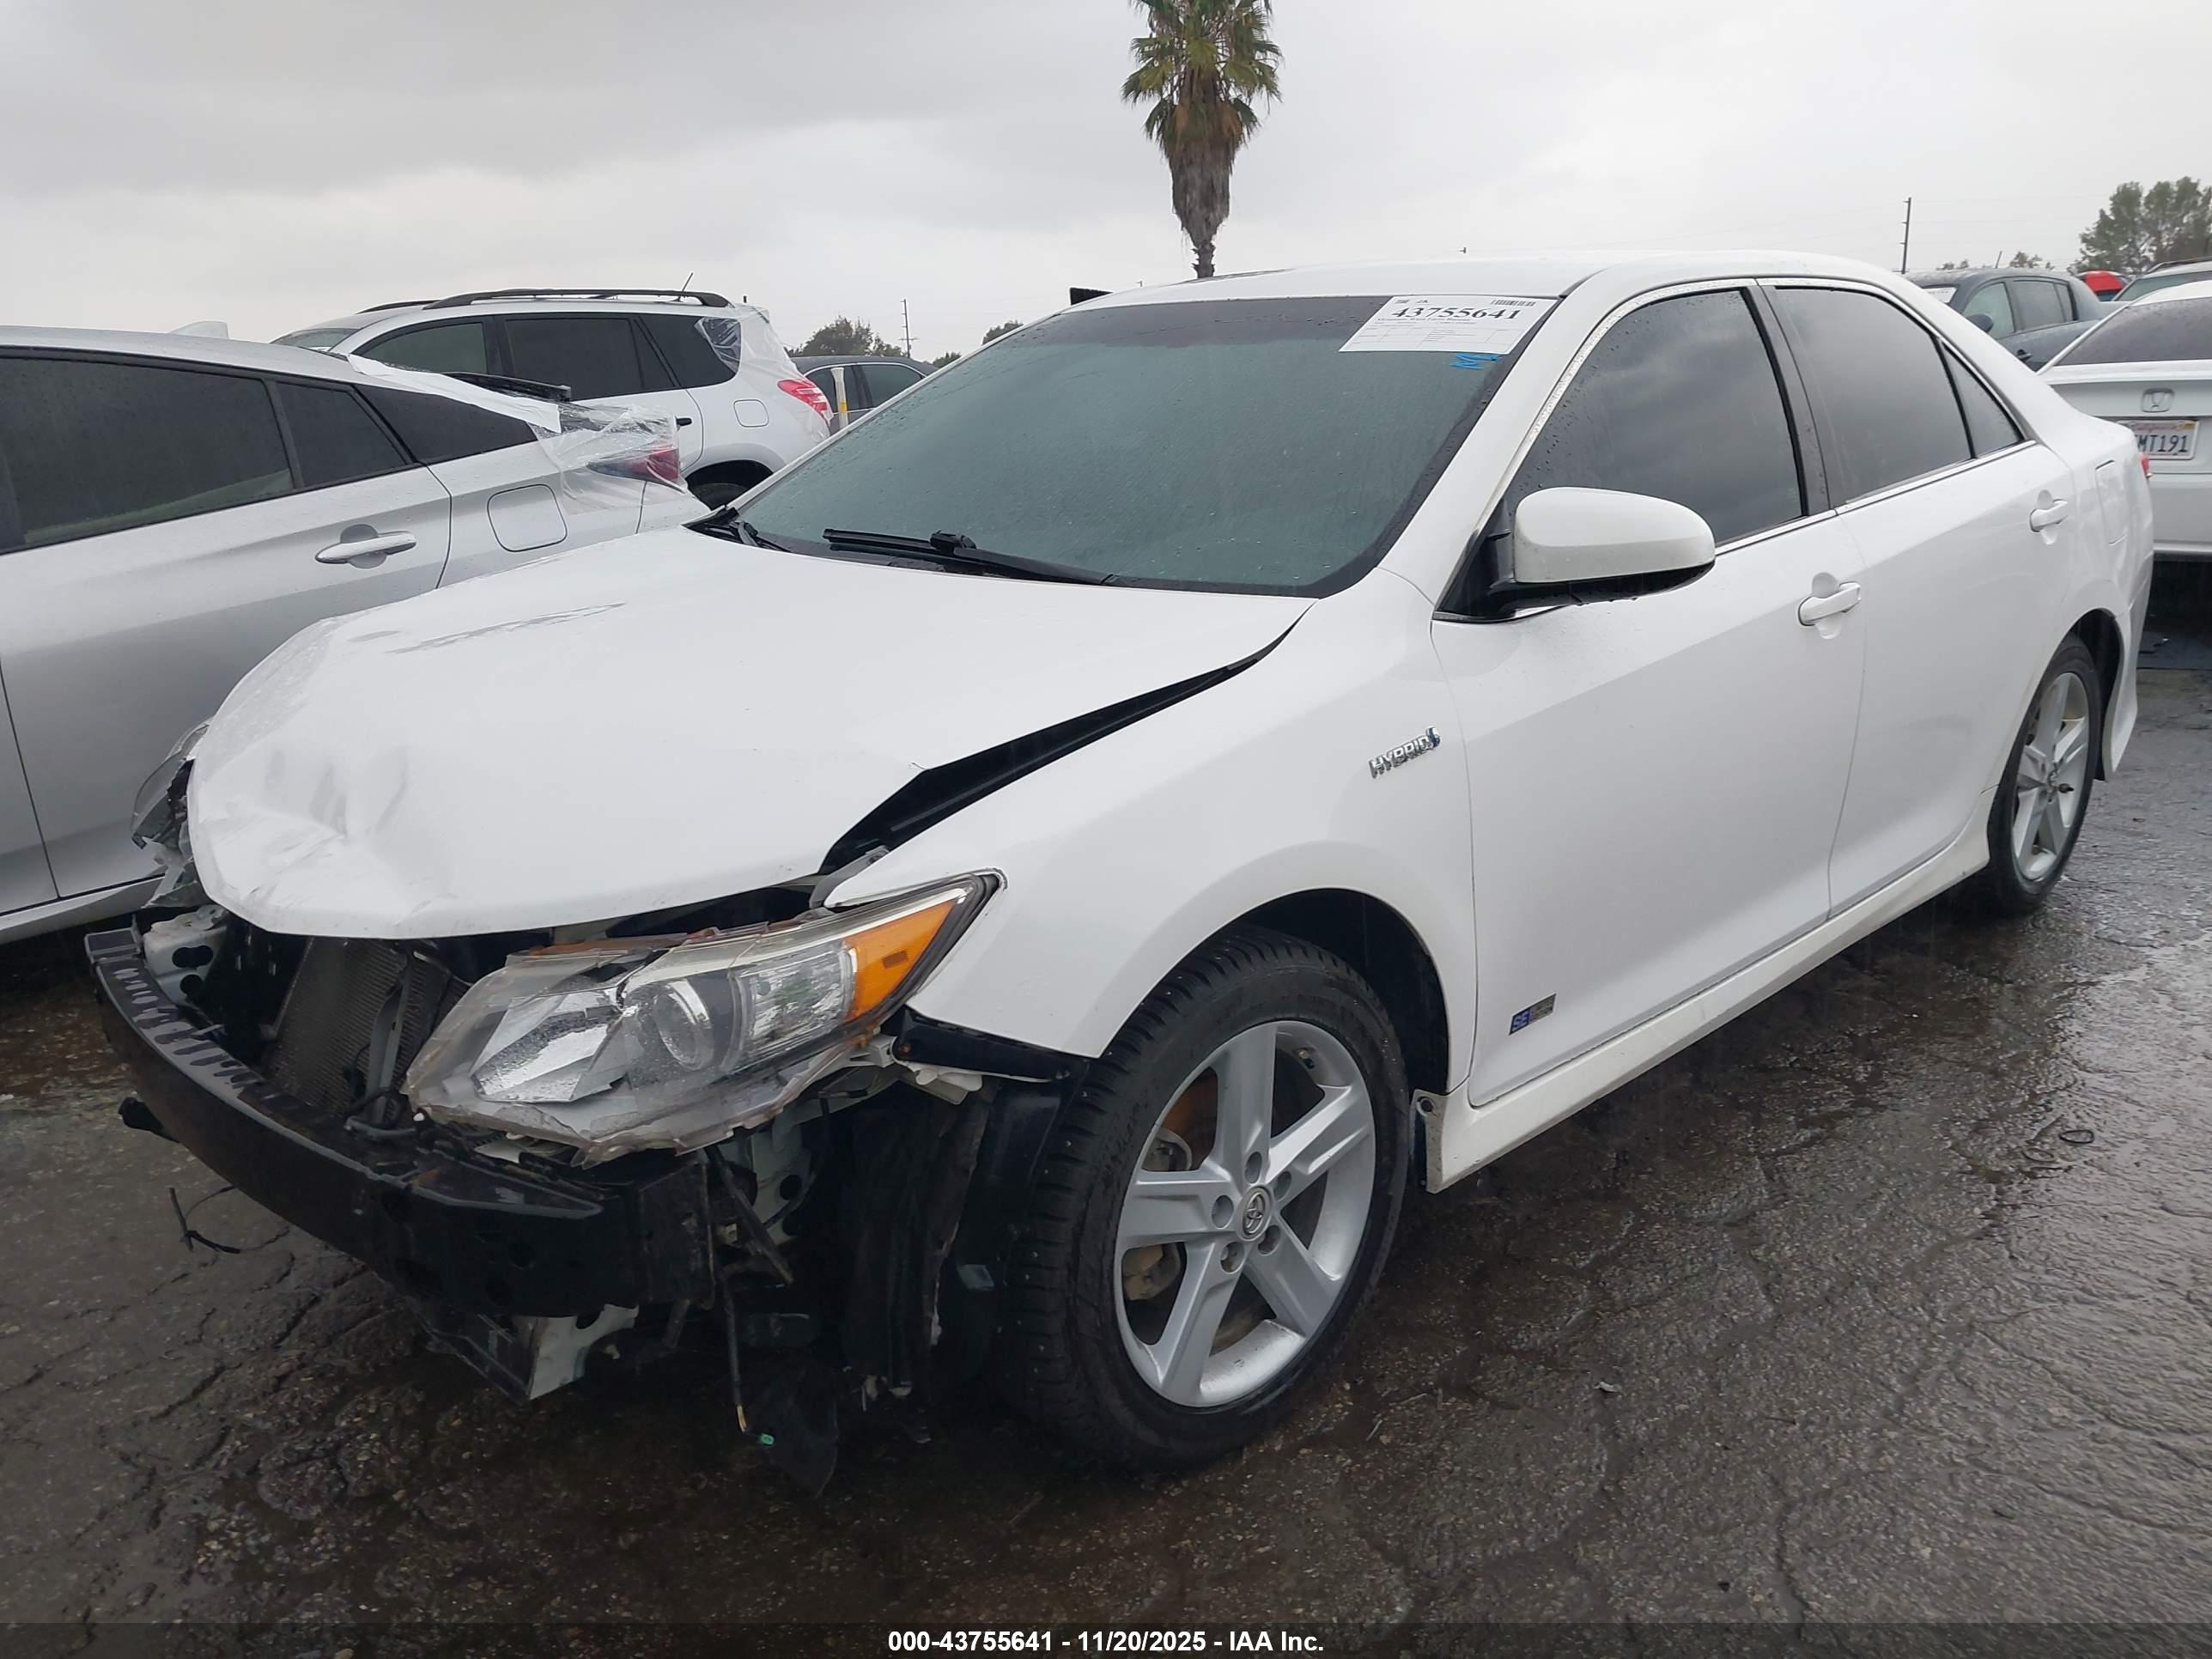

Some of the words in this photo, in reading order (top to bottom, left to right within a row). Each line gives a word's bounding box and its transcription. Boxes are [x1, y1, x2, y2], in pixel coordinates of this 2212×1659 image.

[1391, 307, 1521, 319] 43755641
[2136, 434, 2188, 453] MT191
[1369, 734, 1433, 778] HYBRID
